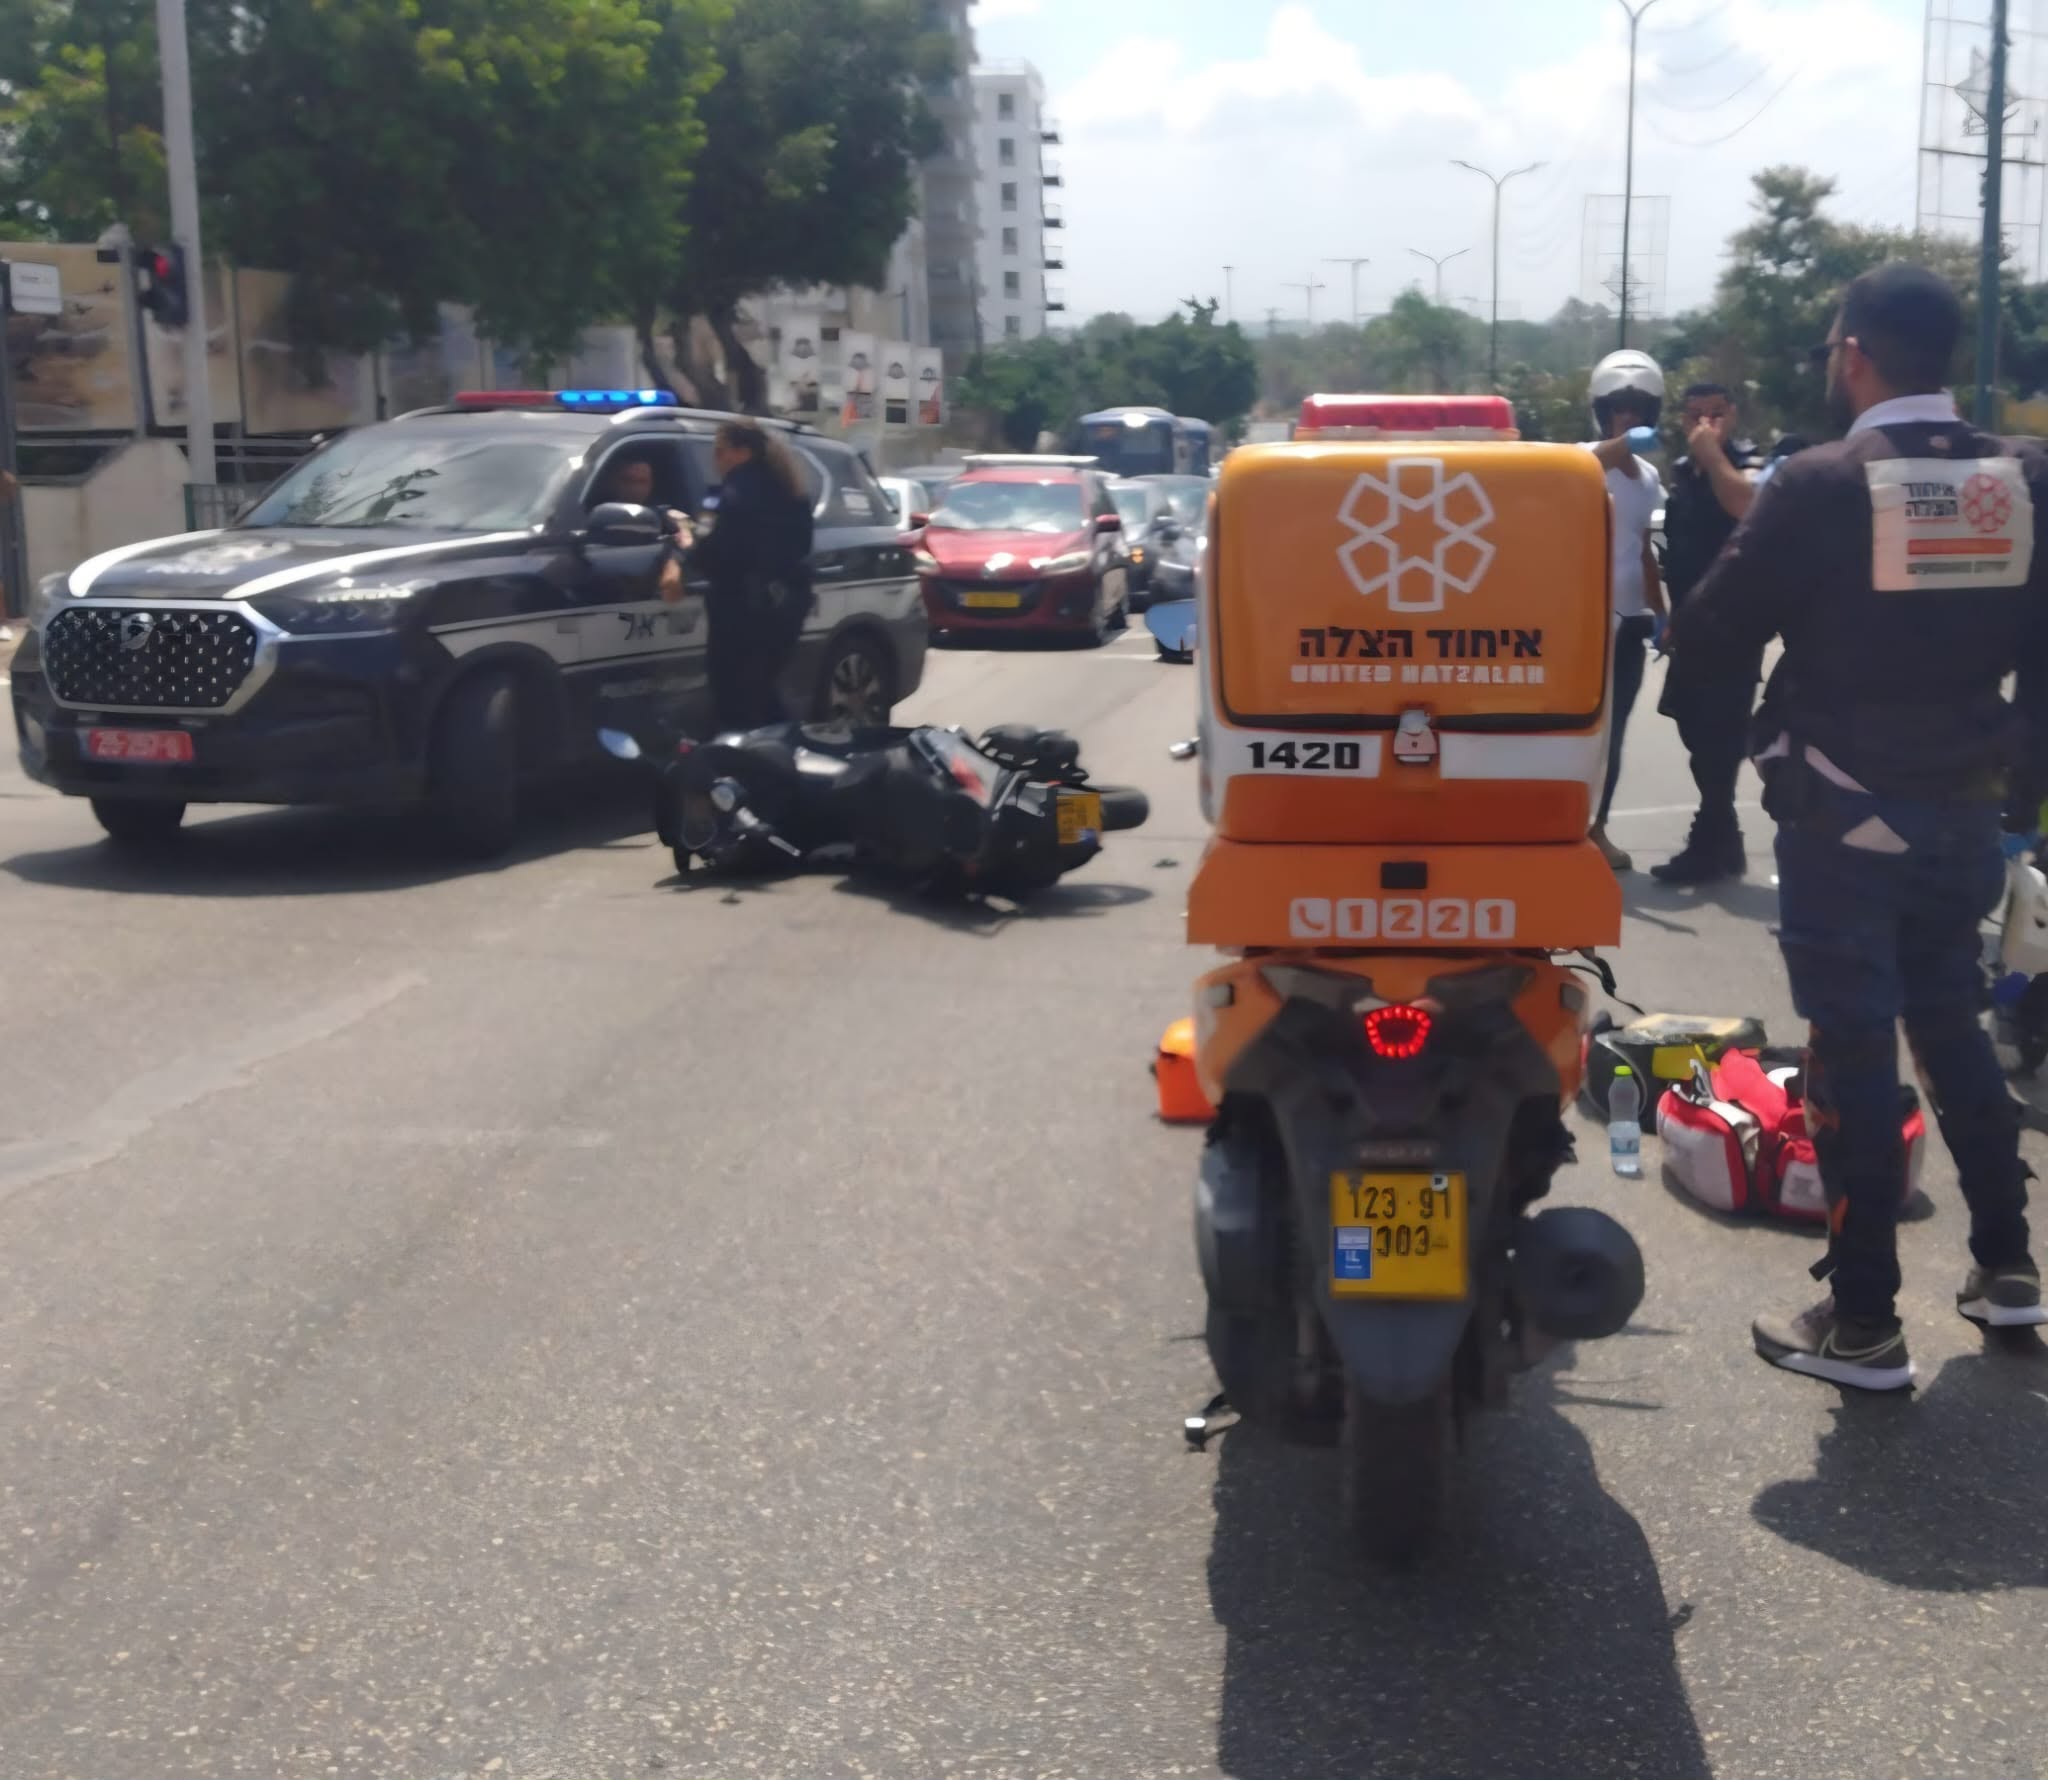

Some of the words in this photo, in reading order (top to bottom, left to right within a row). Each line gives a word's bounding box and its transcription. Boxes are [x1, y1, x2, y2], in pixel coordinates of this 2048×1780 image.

[1299, 626, 1413, 658] הצלה
[1426, 629, 1543, 658] איחוד
[1290, 664, 1392, 683] UNITED
[1401, 664, 1545, 684] HATZALAH
[1246, 741, 1360, 769] 1420
[1344, 902, 1507, 935] 1221
